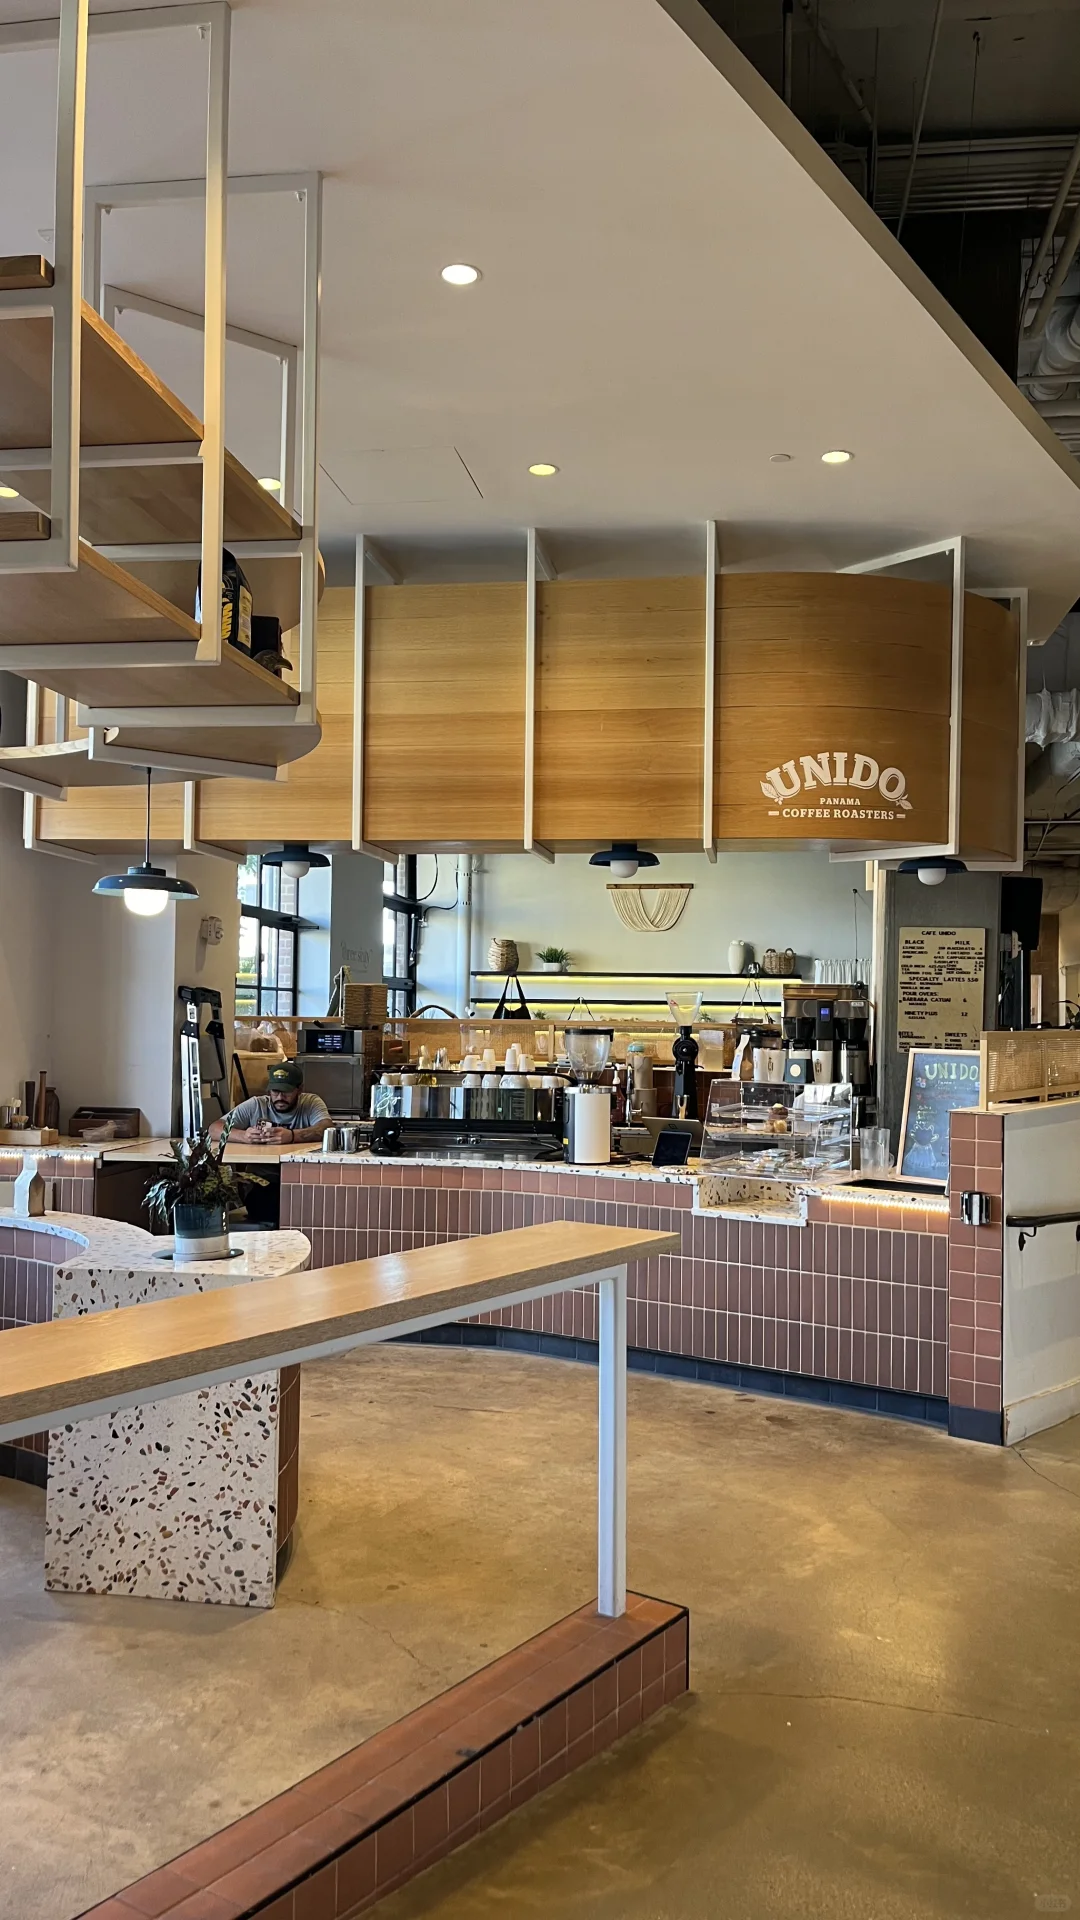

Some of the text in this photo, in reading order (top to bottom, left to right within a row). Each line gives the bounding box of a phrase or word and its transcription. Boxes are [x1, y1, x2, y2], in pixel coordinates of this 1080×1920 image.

[766, 752, 906, 801] UNIDO
[820, 798, 861, 806] PANAMA
[782, 808, 894, 820] COFFEE ROASTERS
[924, 1062, 978, 1080] UNIDO
